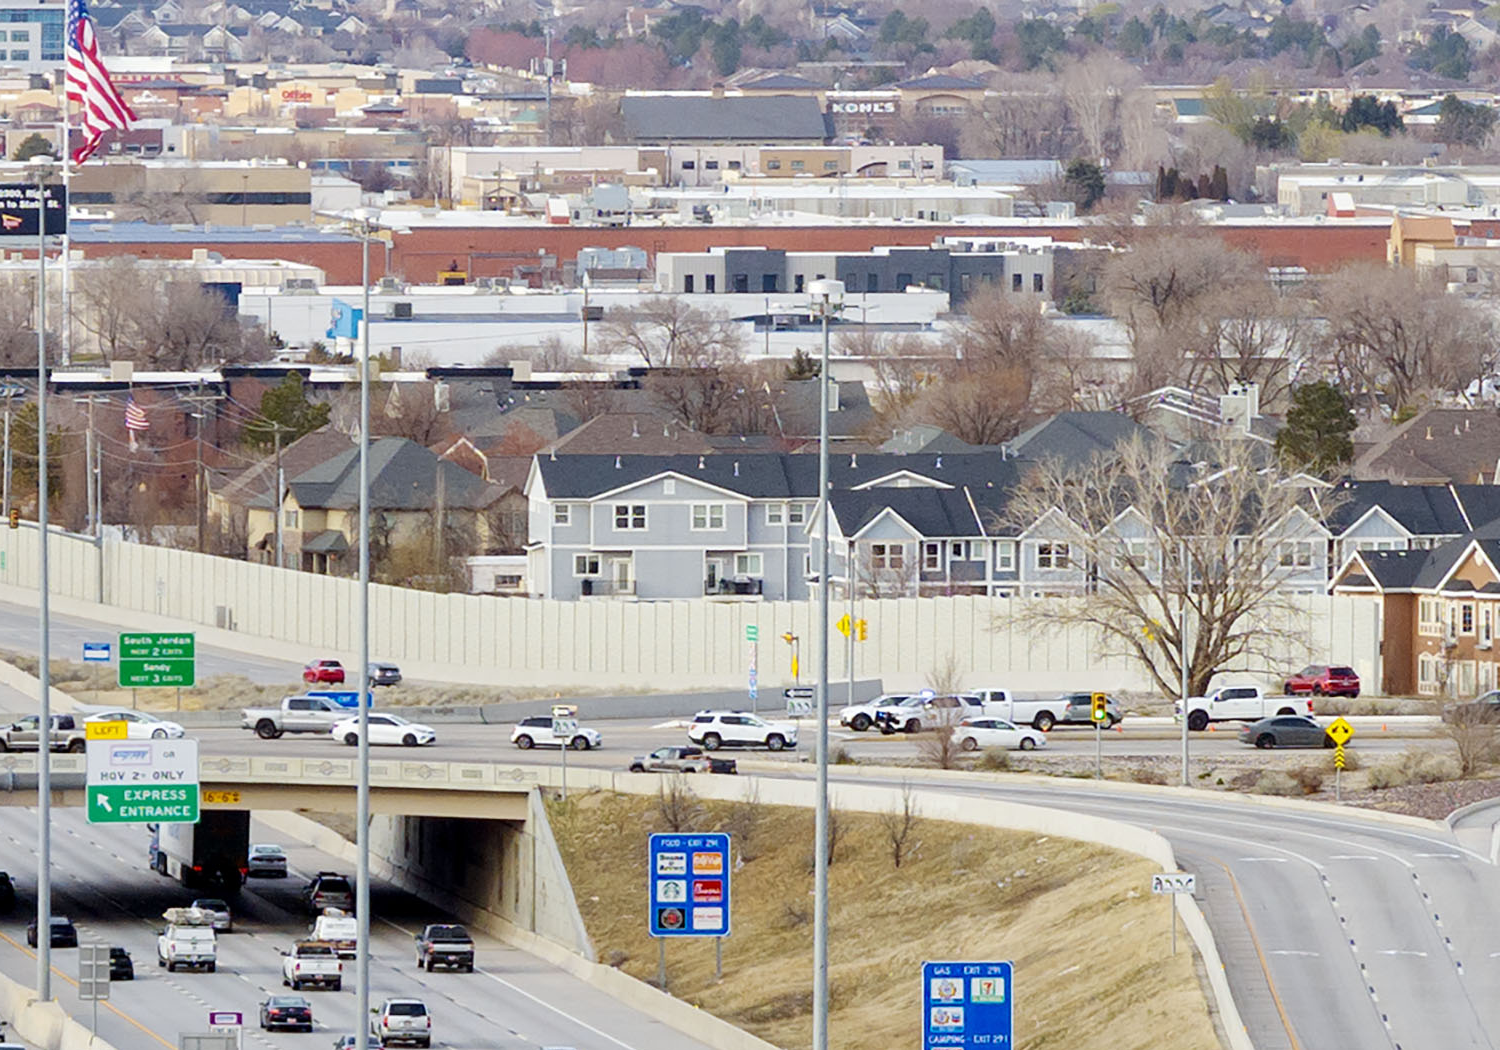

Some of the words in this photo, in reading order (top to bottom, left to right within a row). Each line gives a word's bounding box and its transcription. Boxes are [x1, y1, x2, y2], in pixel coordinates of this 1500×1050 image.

[832, 102, 895, 113] KOHL'S
[123, 636, 153, 645] South
[156, 636, 192, 645] Jordan
[152, 647, 160, 656] 2
[143, 663, 171, 672] Sandy
[152, 674, 160, 683] 3
[94, 726, 120, 736] LEFT
[163, 751, 175, 759] OR
[100, 771, 125, 781] HOV
[152, 770, 184, 780] ONLY
[123, 789, 187, 801] EXPRESS
[119, 805, 191, 817] ENTRANCE
[933, 966, 951, 975] GAS
[963, 966, 980, 975] EXIT
[928, 1034, 966, 1044] CAMPING
[973, 1034, 990, 1044] EXIT
[992, 1034, 1008, 1044] 291
